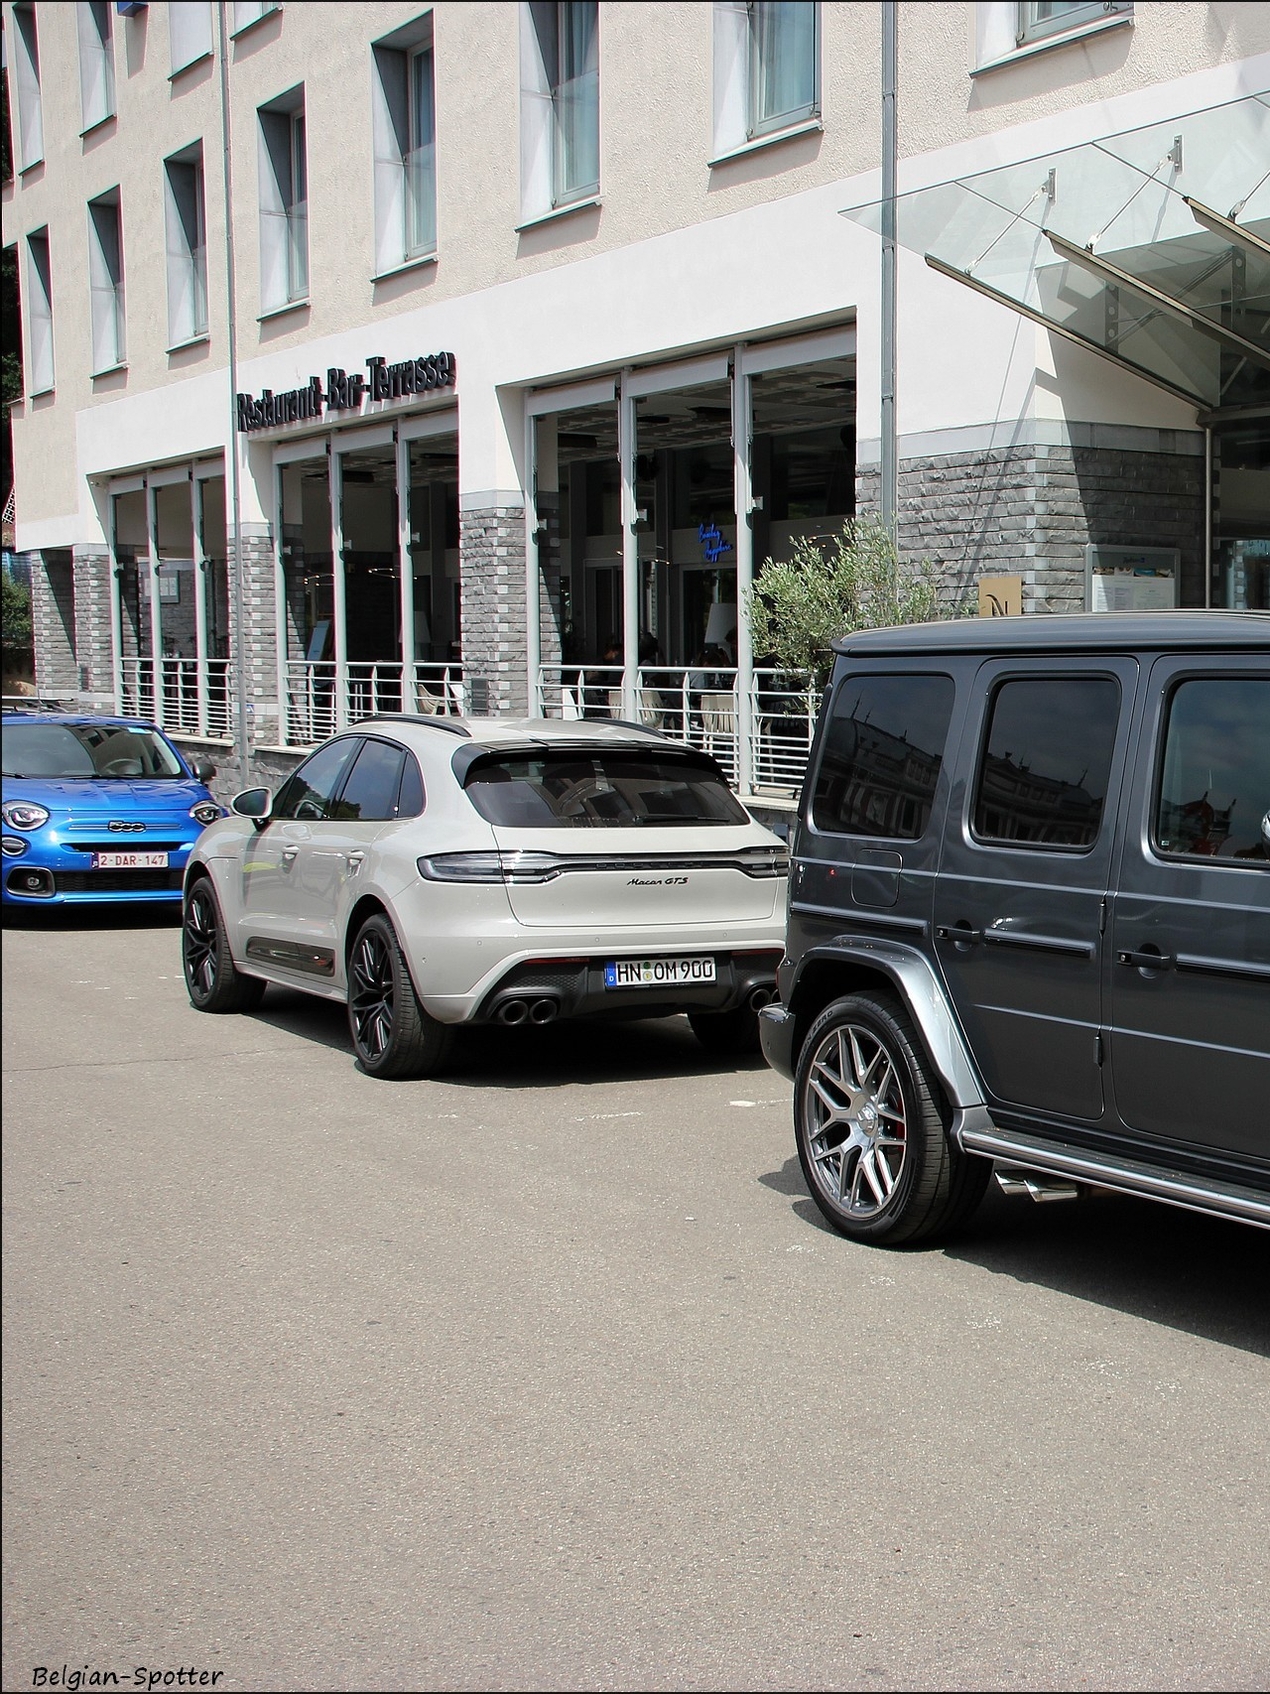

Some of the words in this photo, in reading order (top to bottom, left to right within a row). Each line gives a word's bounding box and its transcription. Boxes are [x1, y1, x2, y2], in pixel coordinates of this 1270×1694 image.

[108, 820, 145, 832] 500
[627, 878, 662, 886] Macan
[664, 877, 689, 885] GTS
[617, 963, 641, 982] HN
[654, 962, 677, 980] OM
[681, 960, 712, 979] 900
